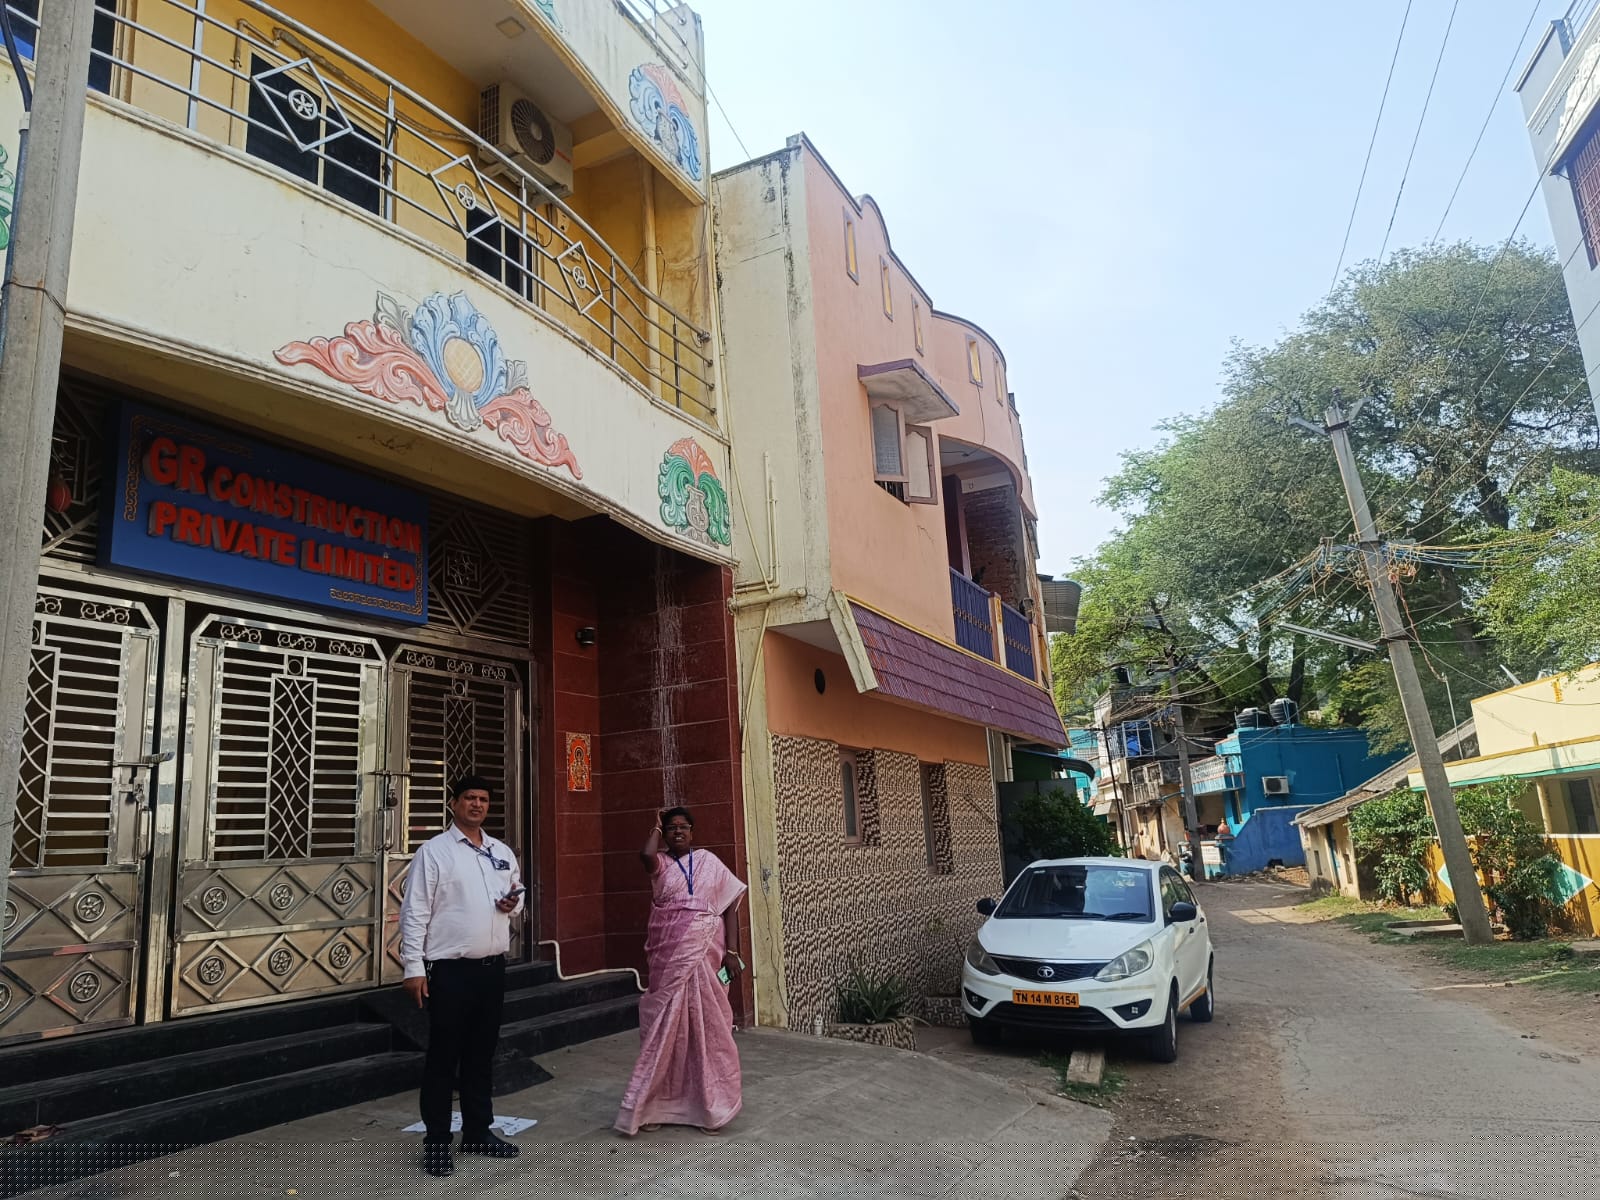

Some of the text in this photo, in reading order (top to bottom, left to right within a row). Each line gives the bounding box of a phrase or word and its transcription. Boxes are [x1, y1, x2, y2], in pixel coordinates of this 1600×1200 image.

[146, 437, 420, 553] GR CONSTRUCTION
[149, 501, 416, 591] PRIVATE LIMITED
[1015, 992, 1077, 1006] TN 14 M 8154
